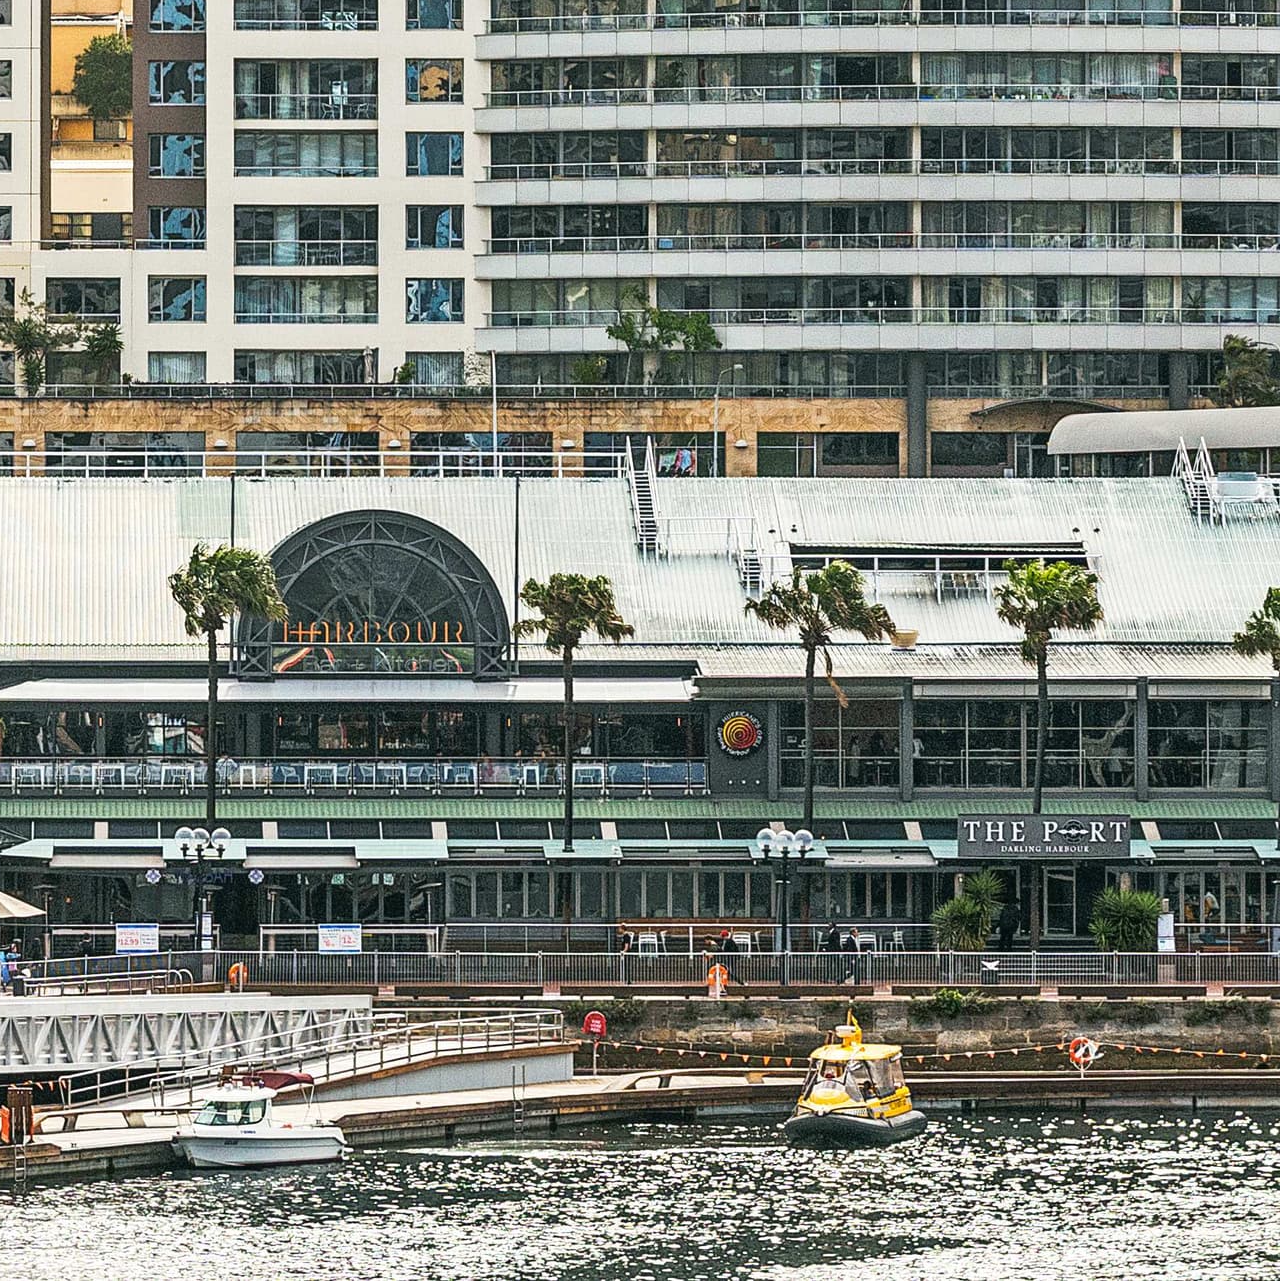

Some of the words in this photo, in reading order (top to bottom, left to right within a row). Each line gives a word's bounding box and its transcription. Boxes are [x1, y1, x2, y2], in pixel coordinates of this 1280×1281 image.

[282, 621, 463, 644] HARBOUR
[963, 820, 1025, 842] THE
[1001, 845, 1041, 853] DARLING
[1045, 845, 1090, 853] HARBOUR
